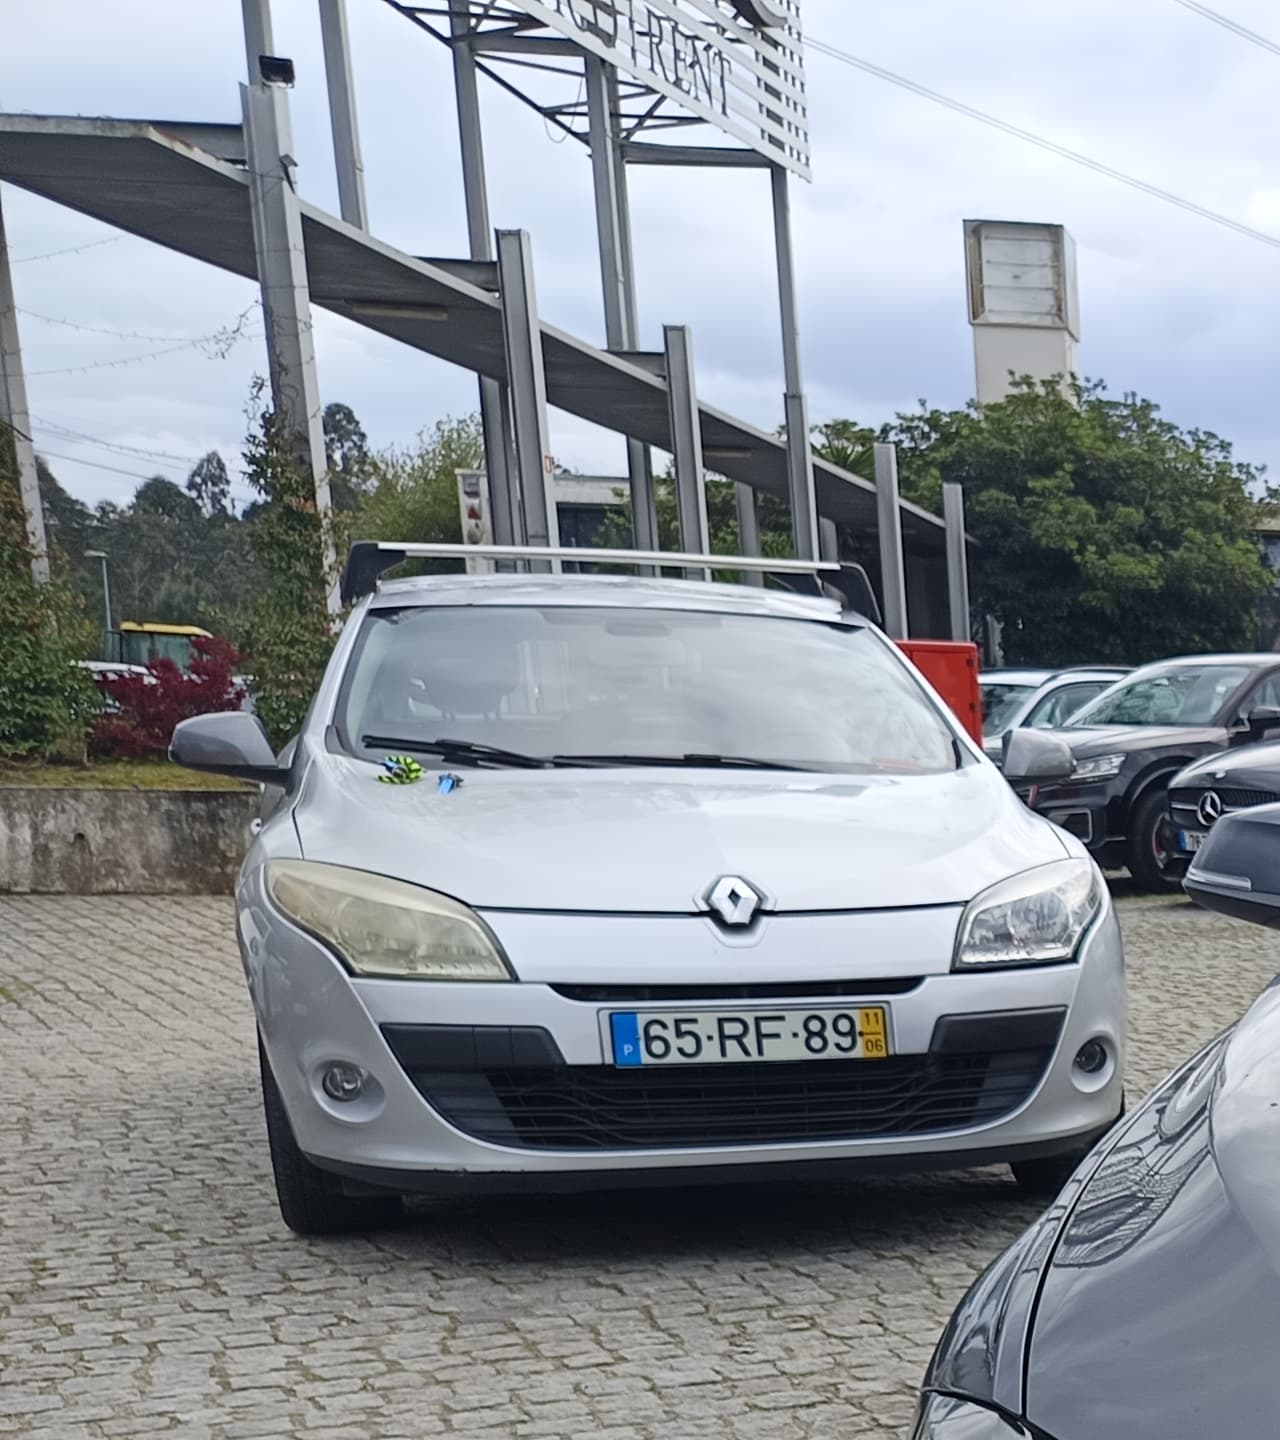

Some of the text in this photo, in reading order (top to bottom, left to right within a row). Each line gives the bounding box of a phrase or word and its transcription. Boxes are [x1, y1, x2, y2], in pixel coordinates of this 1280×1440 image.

[864, 1011, 880, 1025] 11
[623, 1045, 634, 1056] P
[865, 1039, 884, 1053] 06
